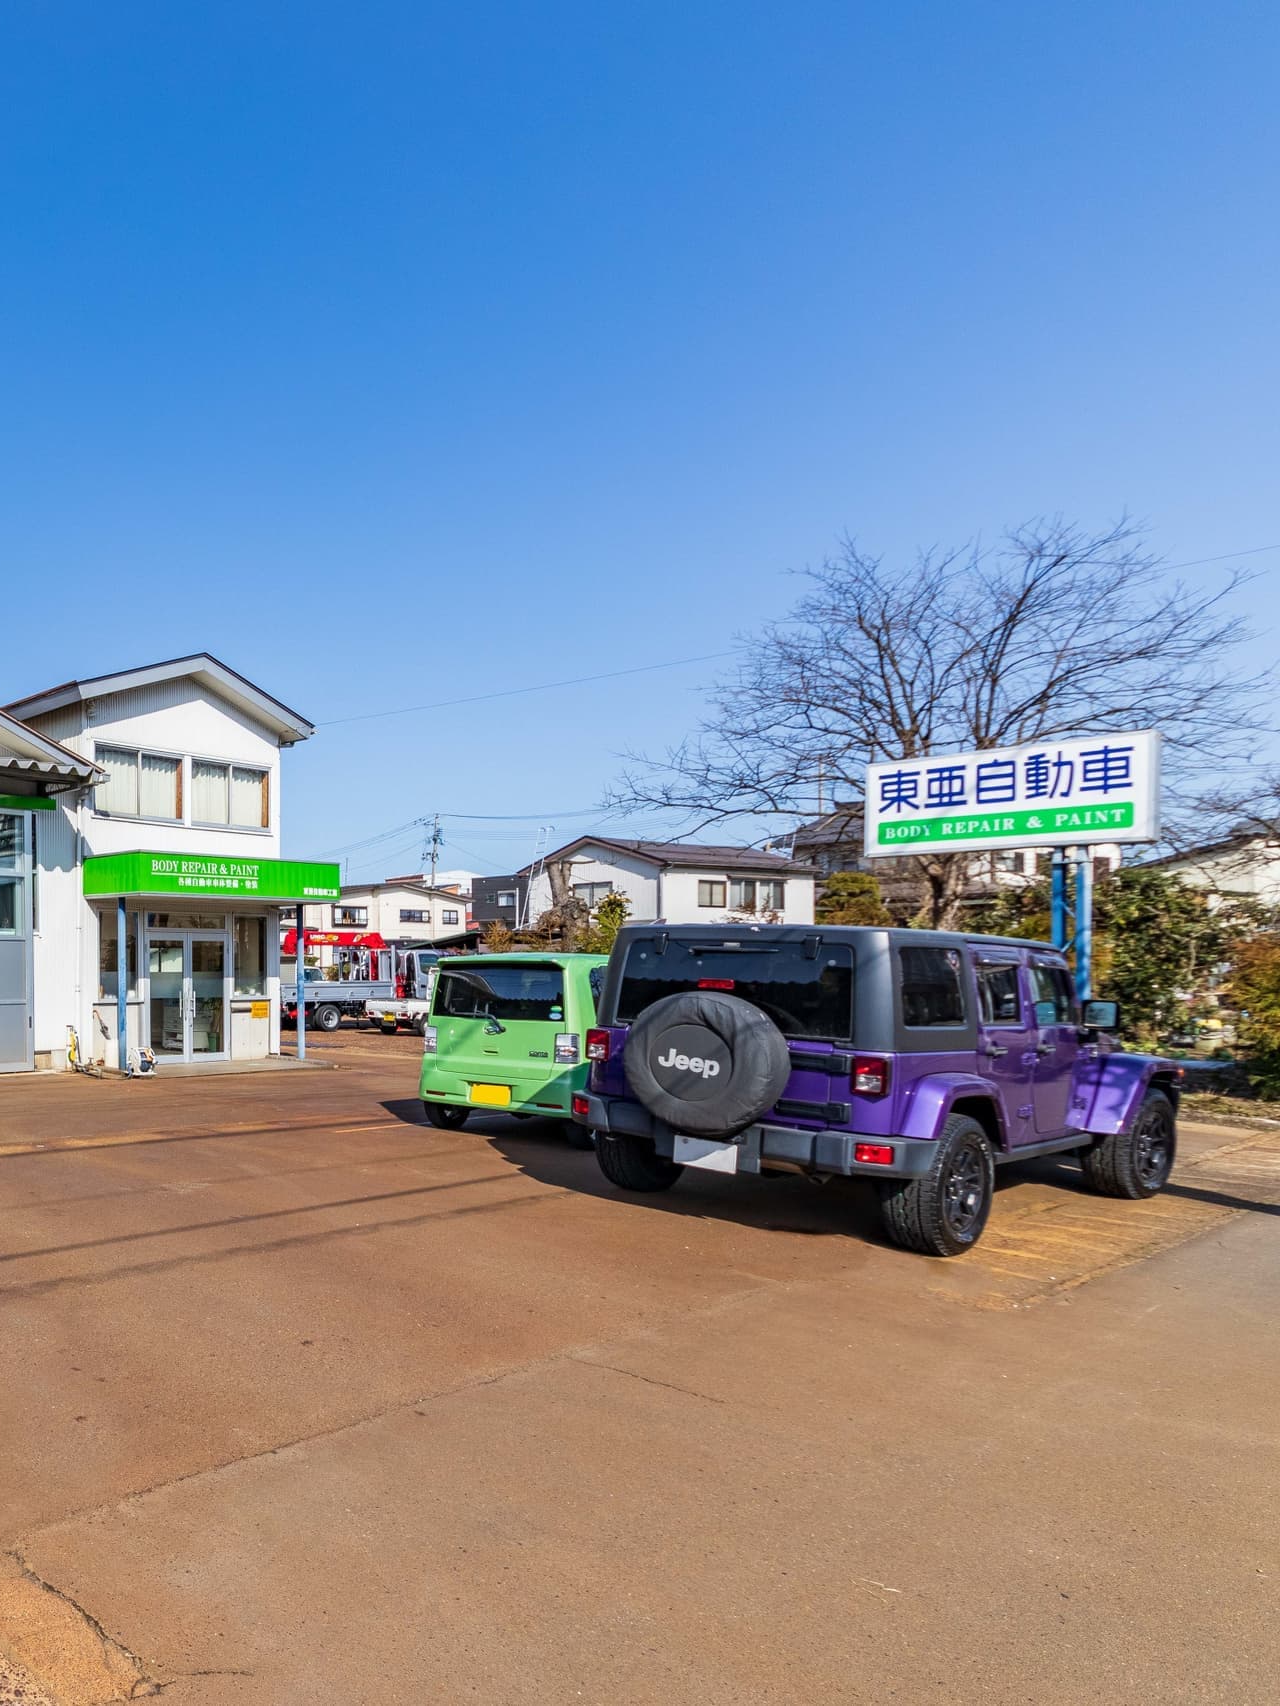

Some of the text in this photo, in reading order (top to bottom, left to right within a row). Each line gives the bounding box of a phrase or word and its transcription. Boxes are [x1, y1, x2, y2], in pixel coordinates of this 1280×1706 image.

[878, 745, 1134, 813] 東亜自動車
[884, 808, 1126, 839] BODY REPAIR & PAINT
[151, 859, 259, 877] BODY REPAIR & PAINT
[658, 1047, 720, 1079] Jeep
